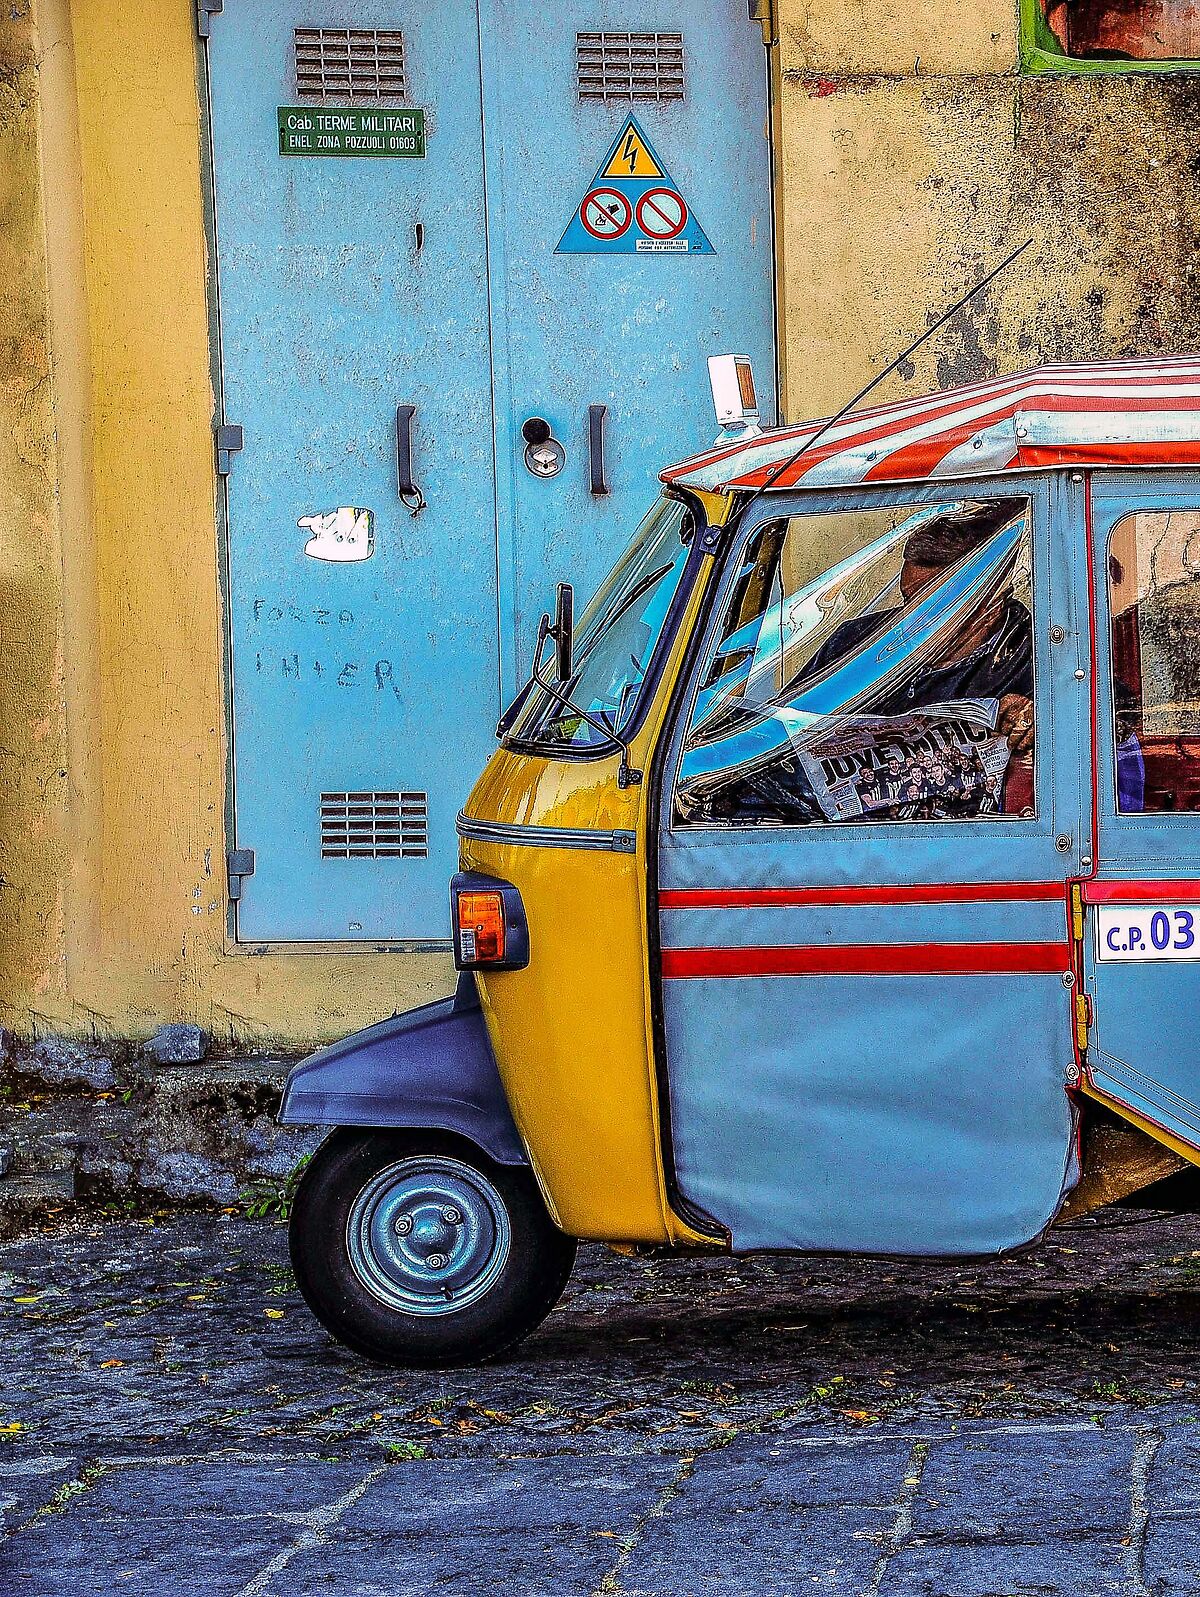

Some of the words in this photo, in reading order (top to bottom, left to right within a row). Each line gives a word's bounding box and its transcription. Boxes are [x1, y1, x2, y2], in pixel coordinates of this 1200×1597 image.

[287, 114, 316, 130] Cab.
[316, 115, 357, 131] TERME
[361, 116, 416, 132] MILITARI
[289, 135, 312, 148] ENEL
[317, 135, 341, 148] ZONA
[345, 136, 385, 149] POZZUOLI
[389, 137, 416, 150] 01603
[1106, 926, 1146, 952] C.P.
